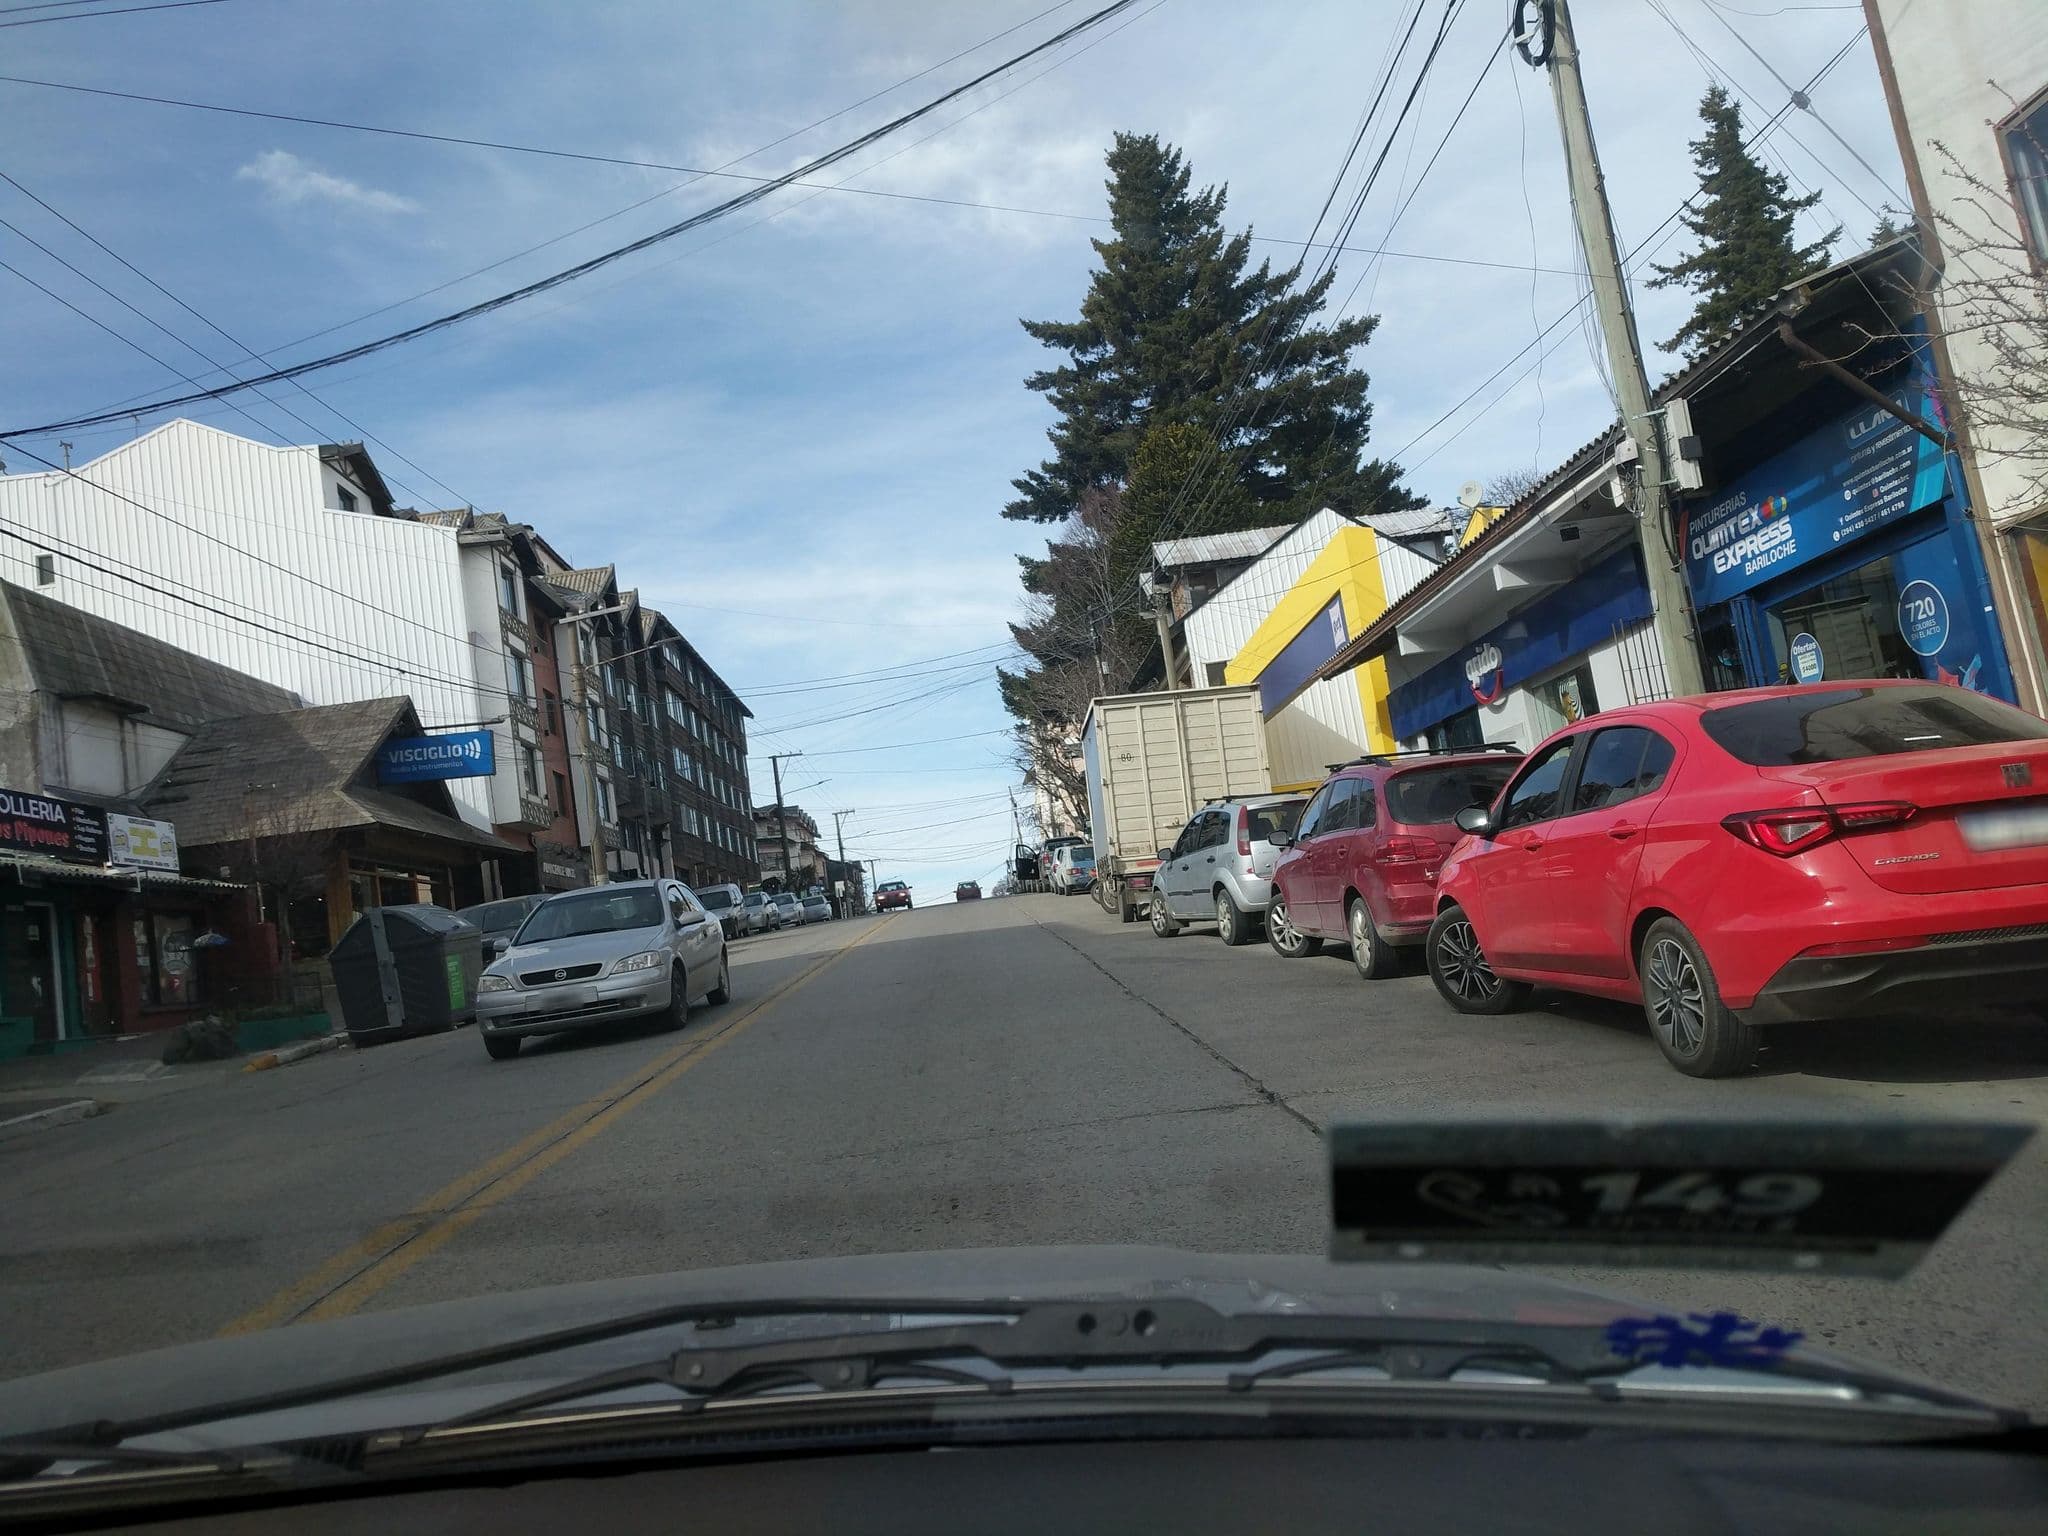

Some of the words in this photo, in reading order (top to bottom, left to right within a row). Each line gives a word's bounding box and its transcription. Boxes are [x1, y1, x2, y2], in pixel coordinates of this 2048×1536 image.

[1689, 491, 1747, 535] PINTURERIAS
[1714, 515, 1793, 574] EXPRESS
[1745, 539, 1796, 576] BARILOCHE
[1905, 597, 1935, 622] 720
[389, 744, 462, 763] VISCIGLIO
[1874, 852, 1940, 866] CRONOS
[1580, 1170, 1824, 1214] 149
